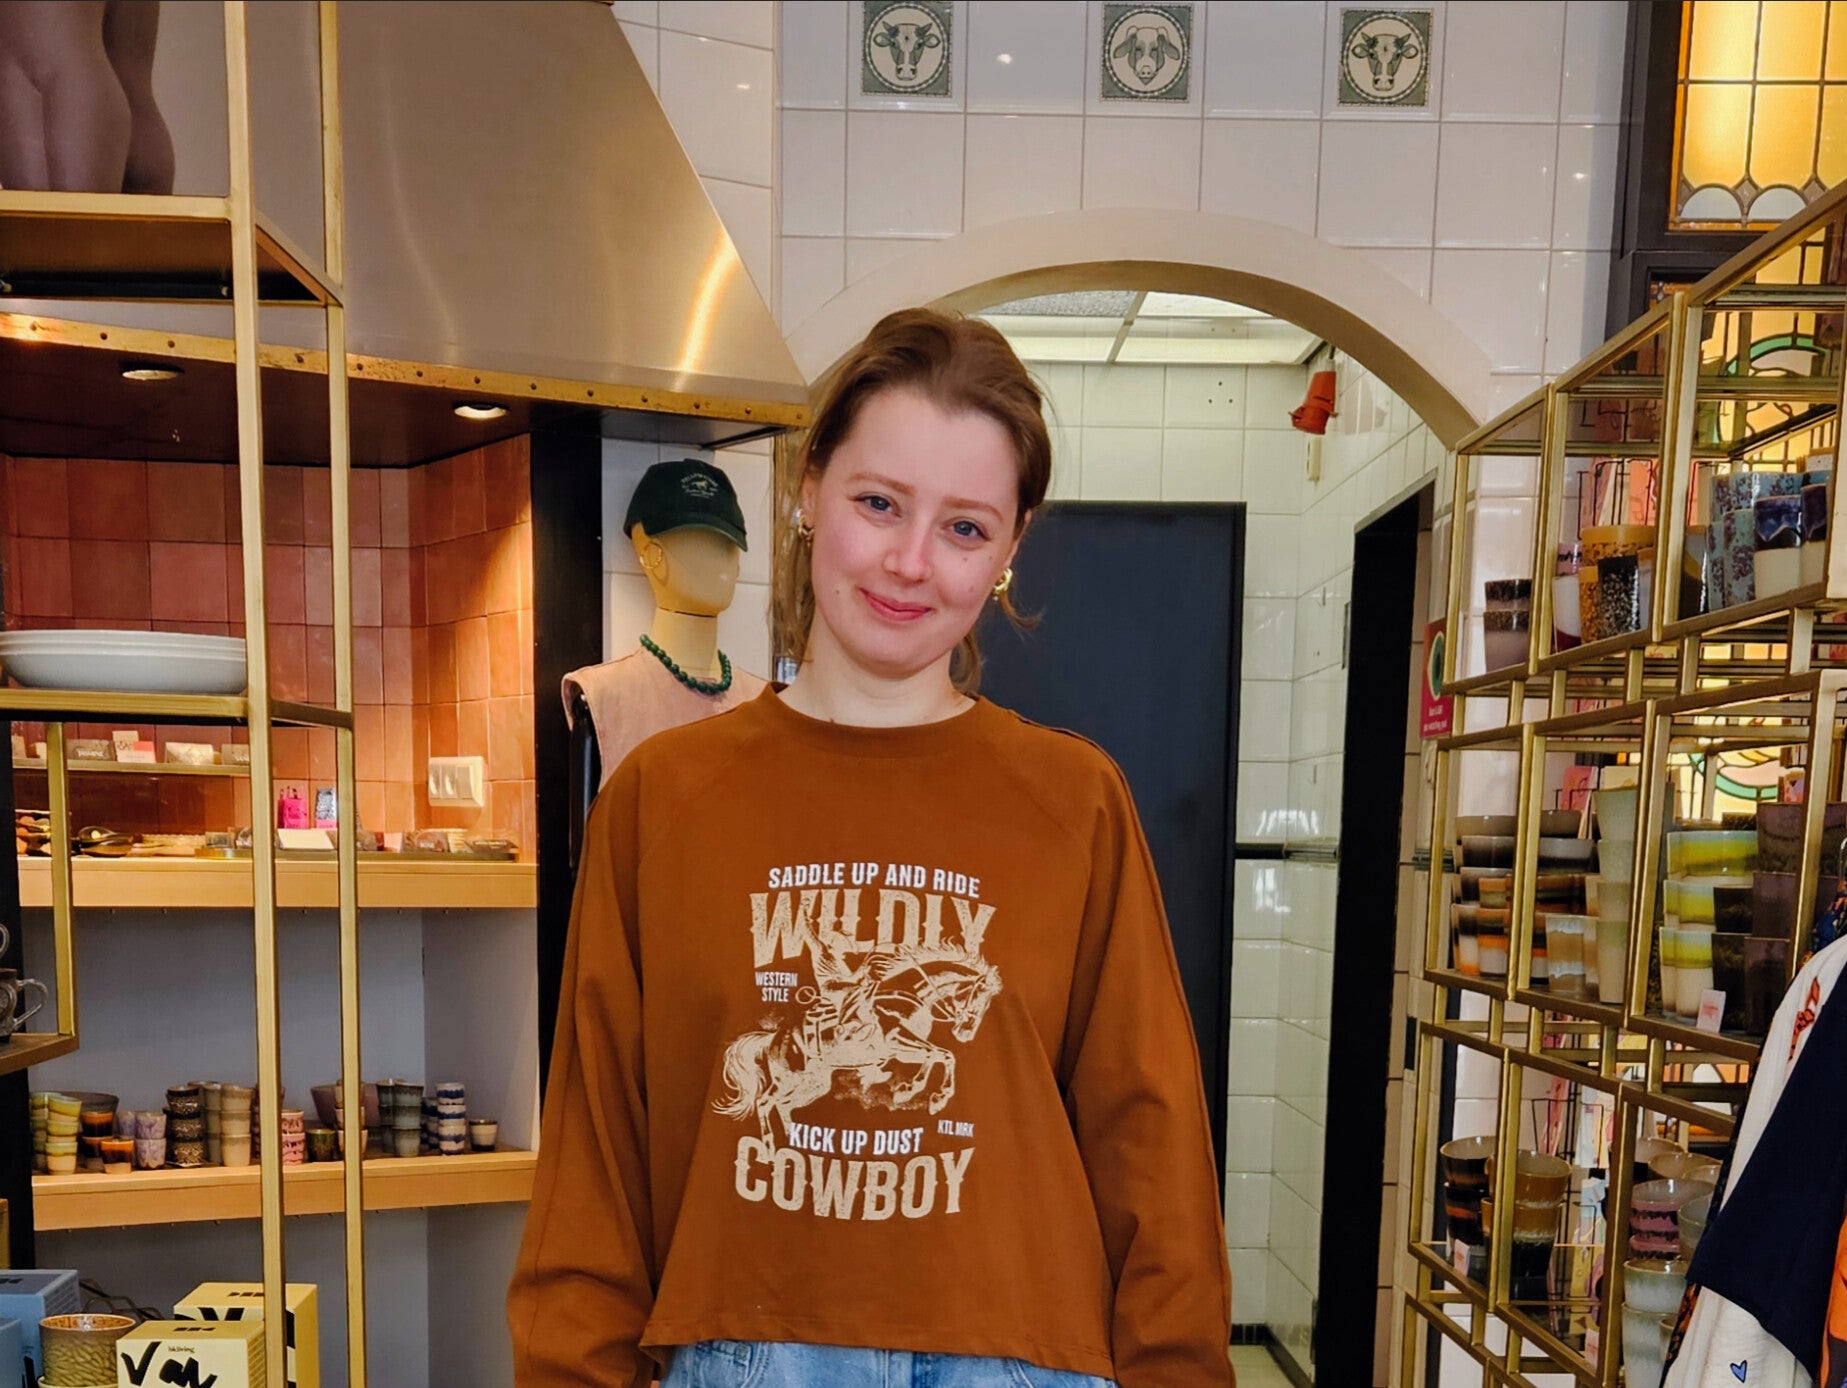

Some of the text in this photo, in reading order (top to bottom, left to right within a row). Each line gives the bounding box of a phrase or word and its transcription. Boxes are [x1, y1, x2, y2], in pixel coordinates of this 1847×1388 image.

[768, 862, 981, 898] SADDLE UP AND RIDE
[749, 888, 997, 969] WILDLY
[755, 971, 798, 987] WESTERN
[761, 987, 789, 1002] STYLE
[788, 1122, 924, 1155] KICK UP DUST
[734, 1135, 976, 1221] COWBOY
